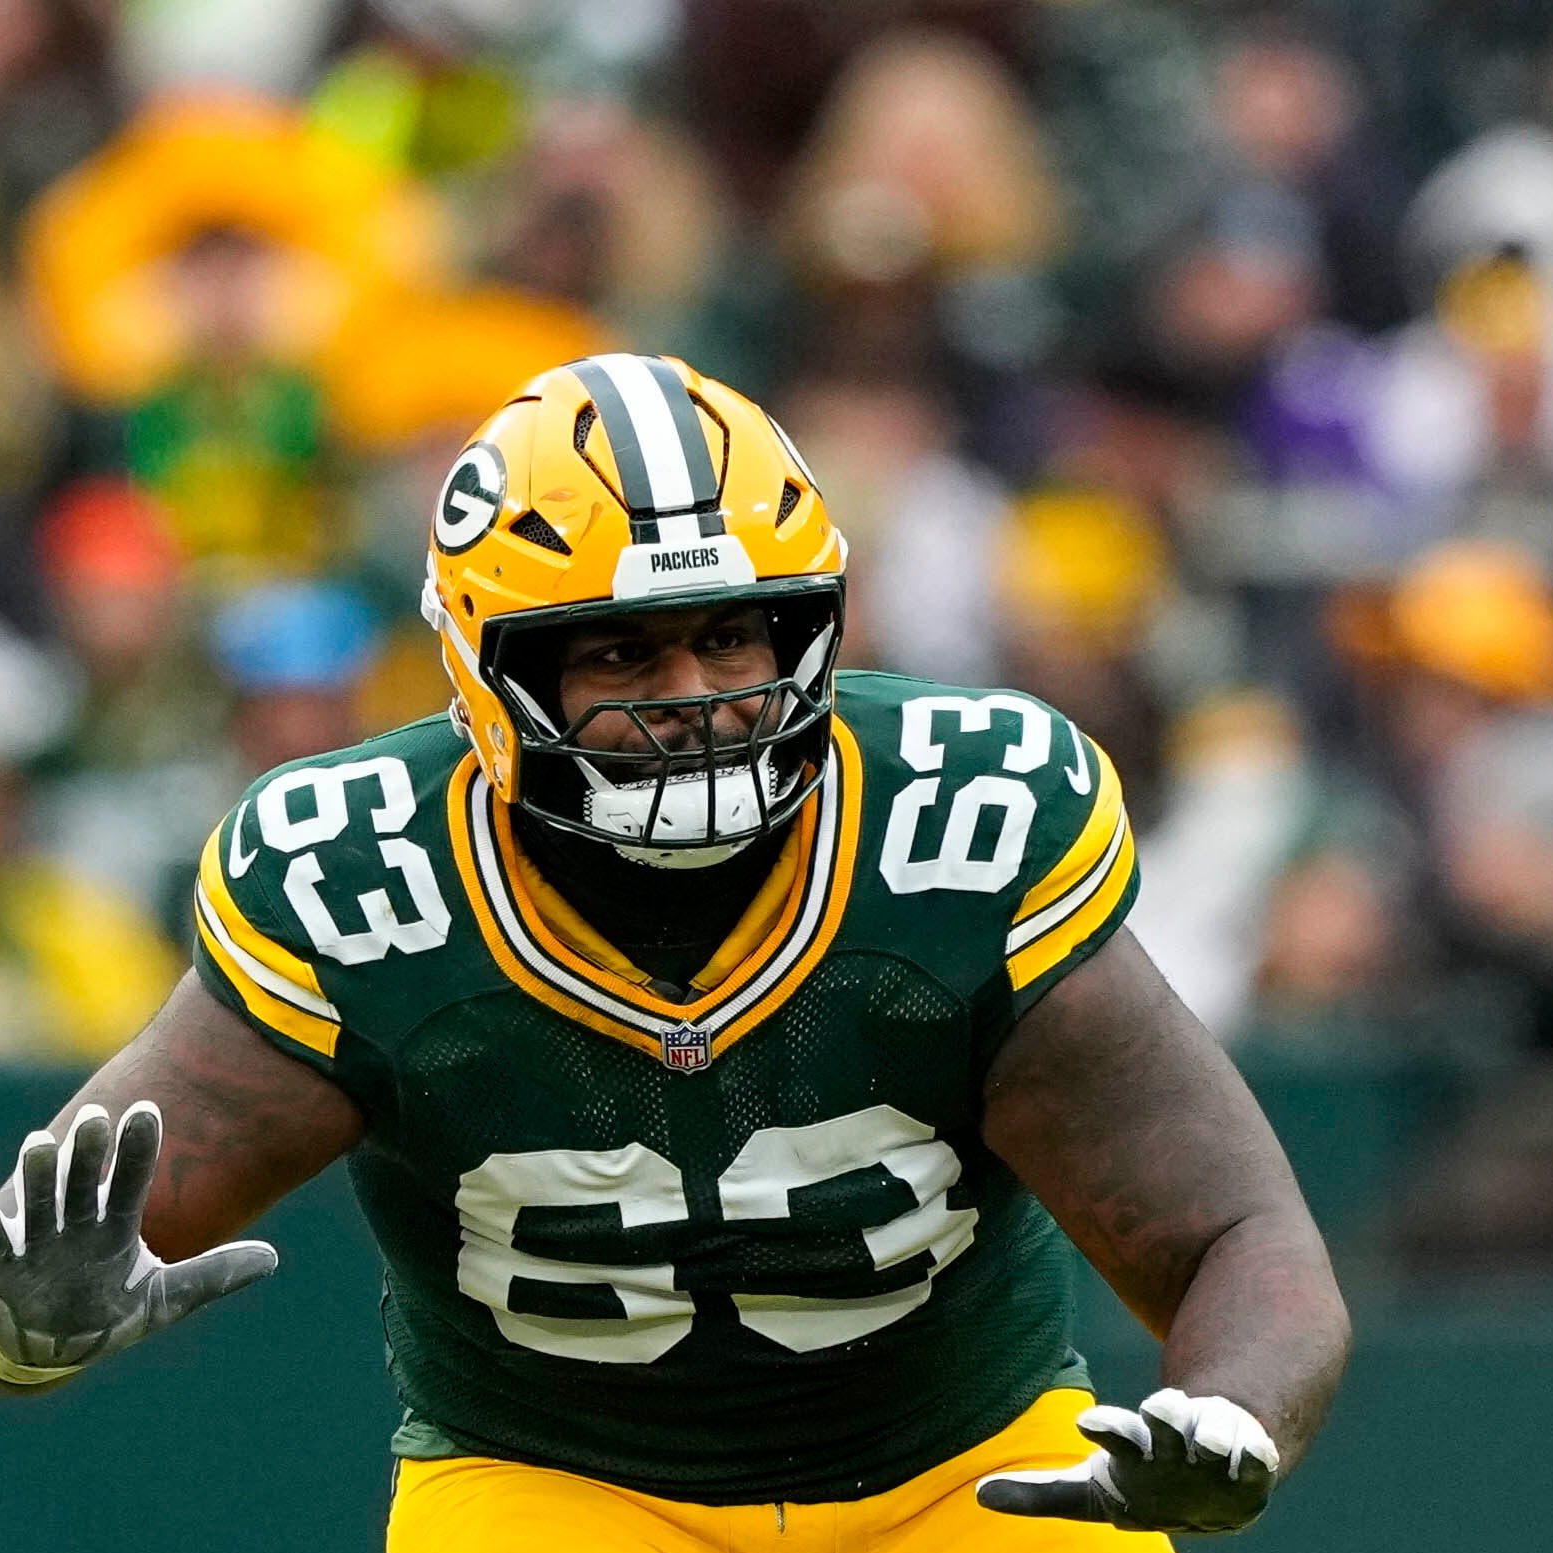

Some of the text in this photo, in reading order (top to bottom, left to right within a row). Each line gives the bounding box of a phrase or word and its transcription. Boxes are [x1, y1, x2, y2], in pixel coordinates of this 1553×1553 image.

[435, 444, 505, 550] G
[650, 547, 719, 573] PACKERS
[257, 756, 453, 966] 63
[878, 694, 1049, 895] 63
[670, 1048, 705, 1068] NFL
[456, 1103, 980, 1365] 63
